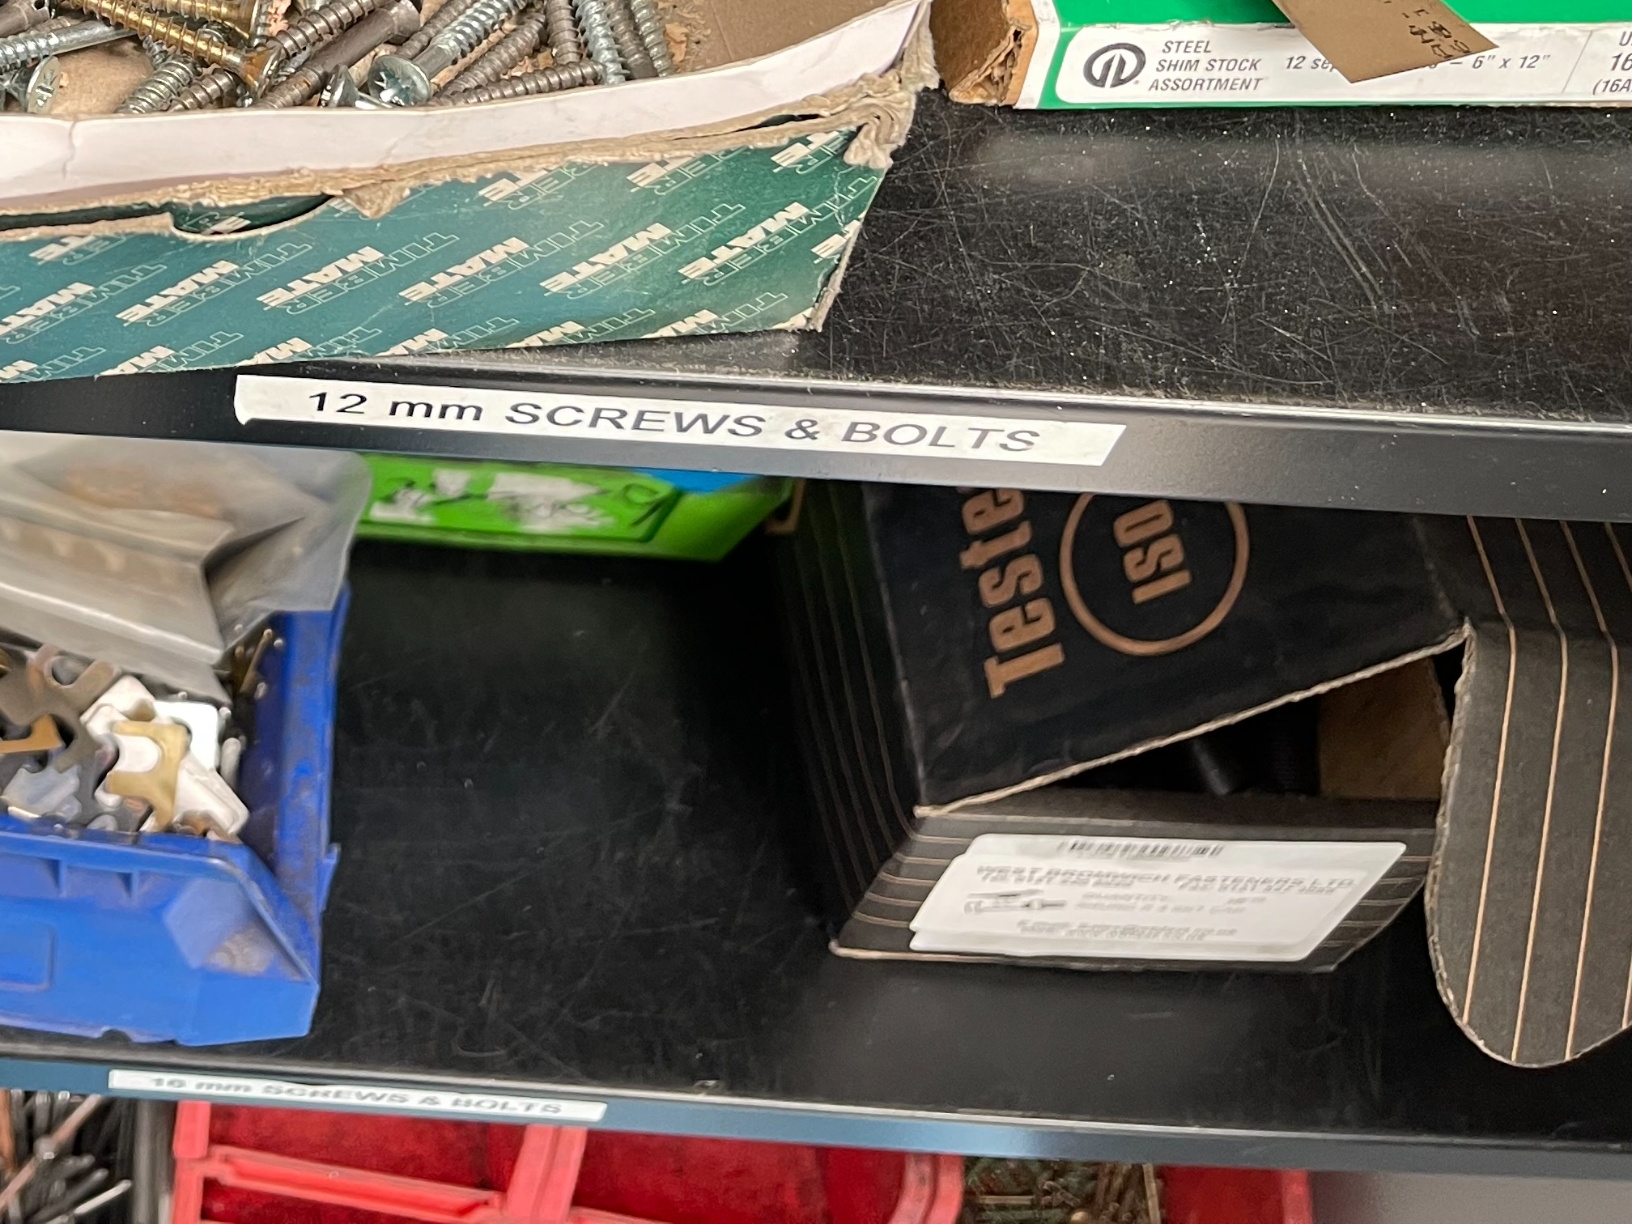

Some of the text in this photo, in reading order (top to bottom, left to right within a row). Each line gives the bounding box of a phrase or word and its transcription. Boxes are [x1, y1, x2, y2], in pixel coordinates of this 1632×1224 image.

[1155, 57, 1263, 73] SHIM STOCK
[1162, 40, 1213, 54] STEEL
[1284, 56, 1307, 71] 12
[1471, 54, 1496, 70] 6"
[1498, 57, 1512, 70] x
[1517, 53, 1552, 70] 12"
[1148, 76, 1264, 93] ASSORTMENT
[397, 236, 530, 308] MATE
[538, 221, 674, 297] MATE
[677, 201, 809, 285] MATE
[116, 259, 240, 326] MATE
[256, 245, 385, 312] MATE
[307, 390, 1042, 455] 12 mm SCREWS & BOLTS
[1113, 499, 1193, 605] ISO
[958, 487, 1066, 700] Teste
[196, 1080, 254, 1095] mm
[261, 1083, 411, 1107] SCREWS
[418, 1095, 443, 1108] &
[448, 1096, 565, 1116] BOLTS
